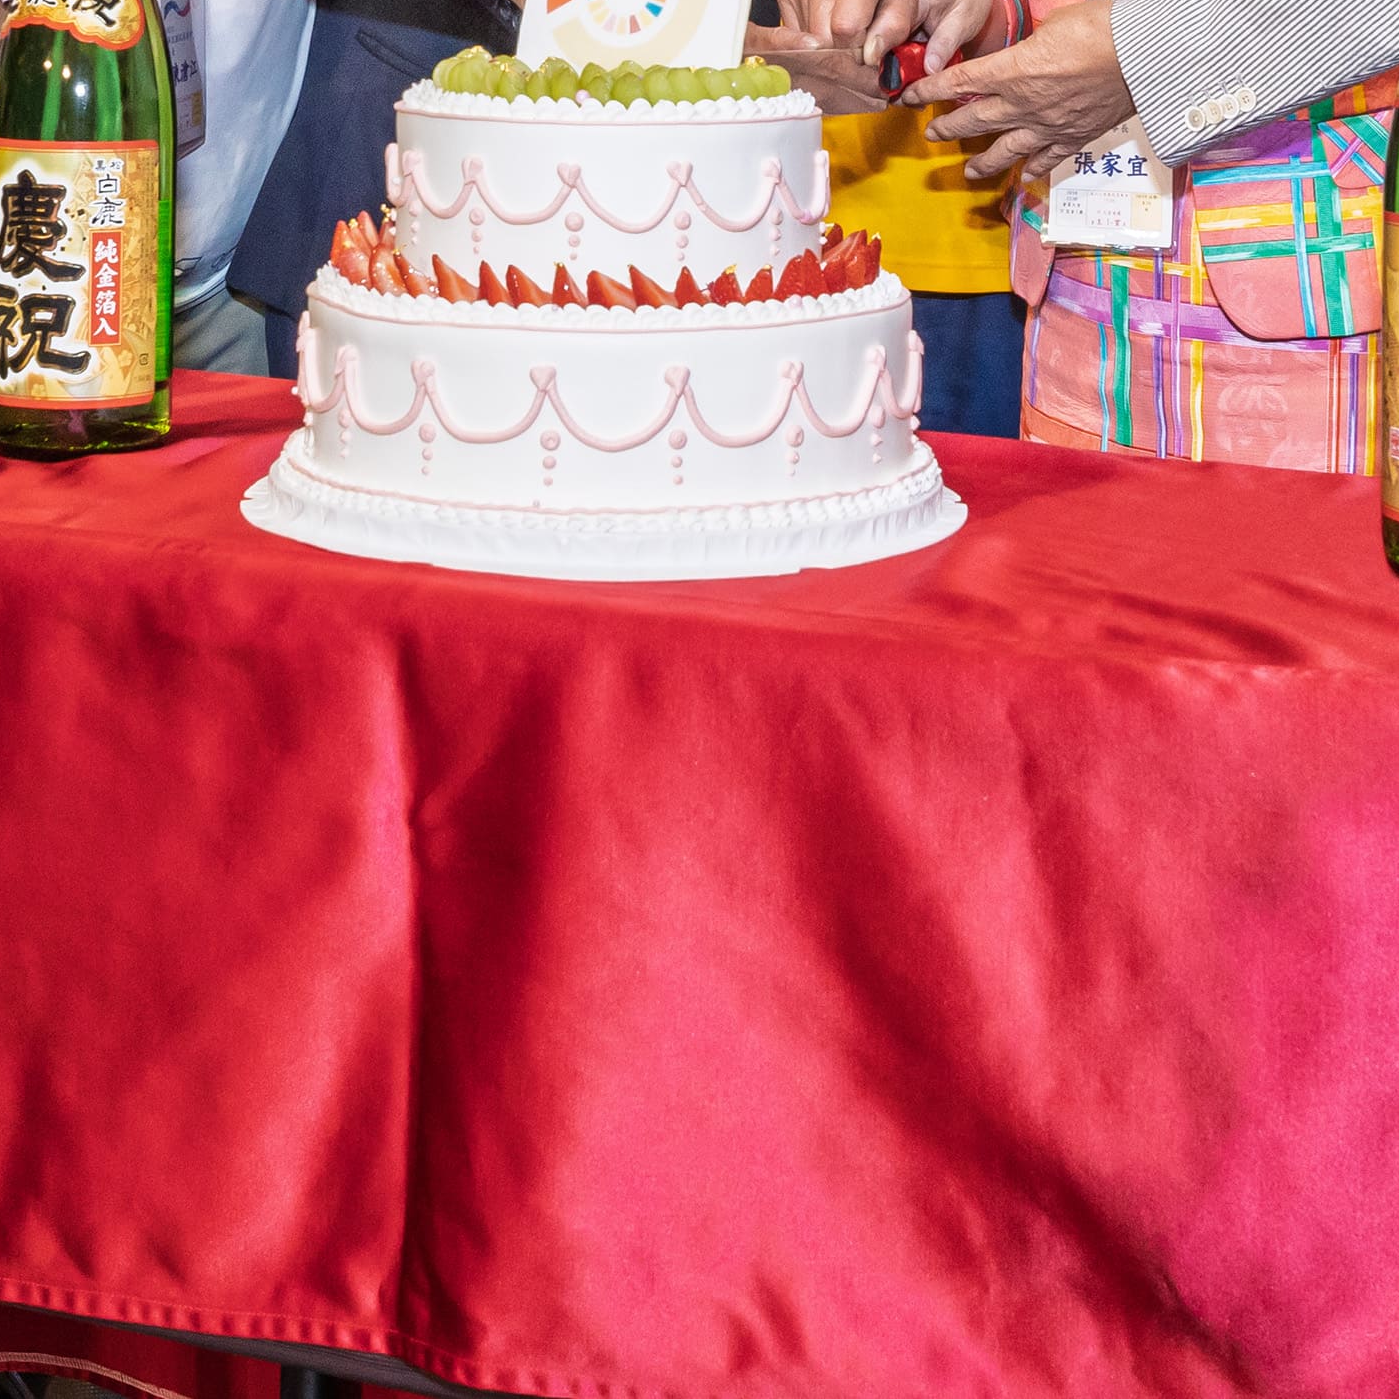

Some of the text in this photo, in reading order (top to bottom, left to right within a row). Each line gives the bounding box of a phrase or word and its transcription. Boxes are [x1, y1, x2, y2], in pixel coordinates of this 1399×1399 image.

[1074, 152, 1148, 177] 張家宜
[93, 239, 119, 337] 純金箔入
